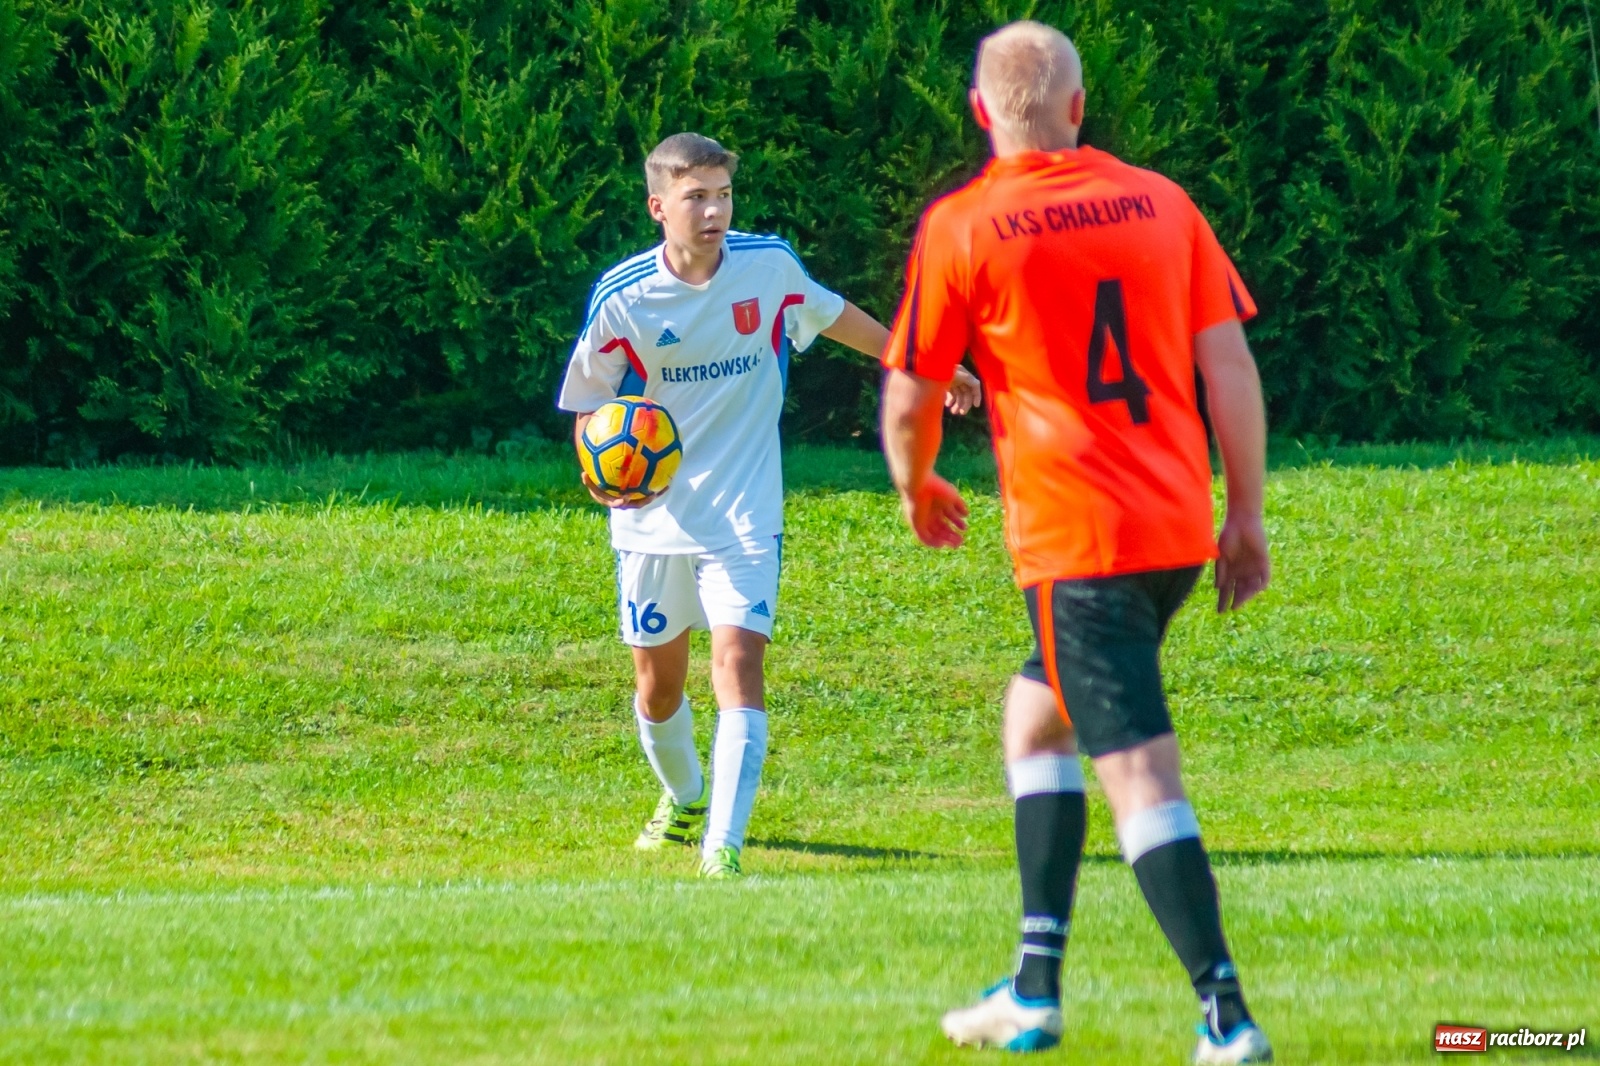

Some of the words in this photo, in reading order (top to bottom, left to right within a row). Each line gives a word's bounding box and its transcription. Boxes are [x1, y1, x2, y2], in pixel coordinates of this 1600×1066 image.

[992, 210, 1042, 240] LKS
[1044, 194, 1156, 232] CHAŁUPKI
[1086, 278, 1153, 425] 4
[628, 600, 667, 634] 16
